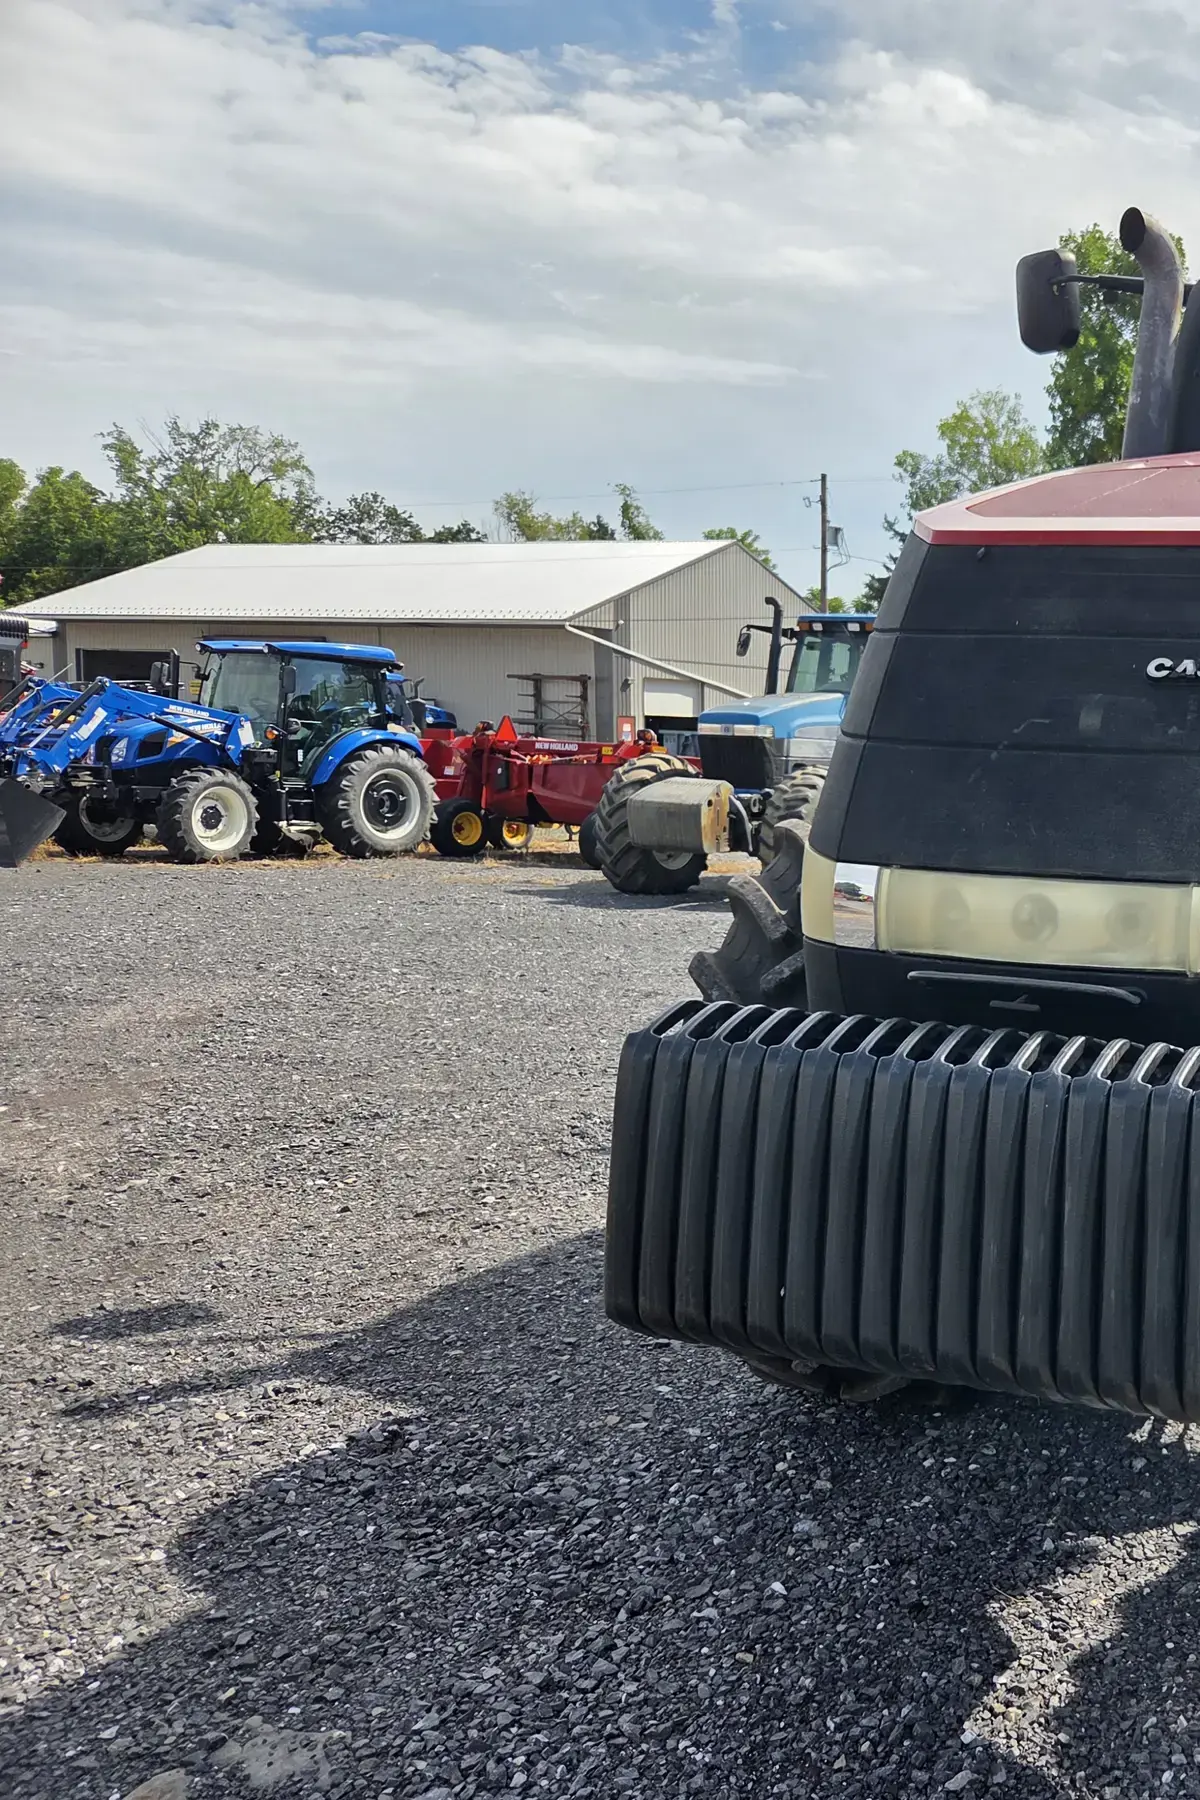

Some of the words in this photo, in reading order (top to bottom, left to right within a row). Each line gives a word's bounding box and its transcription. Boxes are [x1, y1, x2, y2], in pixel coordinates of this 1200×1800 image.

[169, 704, 183, 712] NEW
[183, 707, 210, 716] HOLLAND
[535, 741, 550, 750] NEW
[550, 742, 578, 751] HOLLAND
